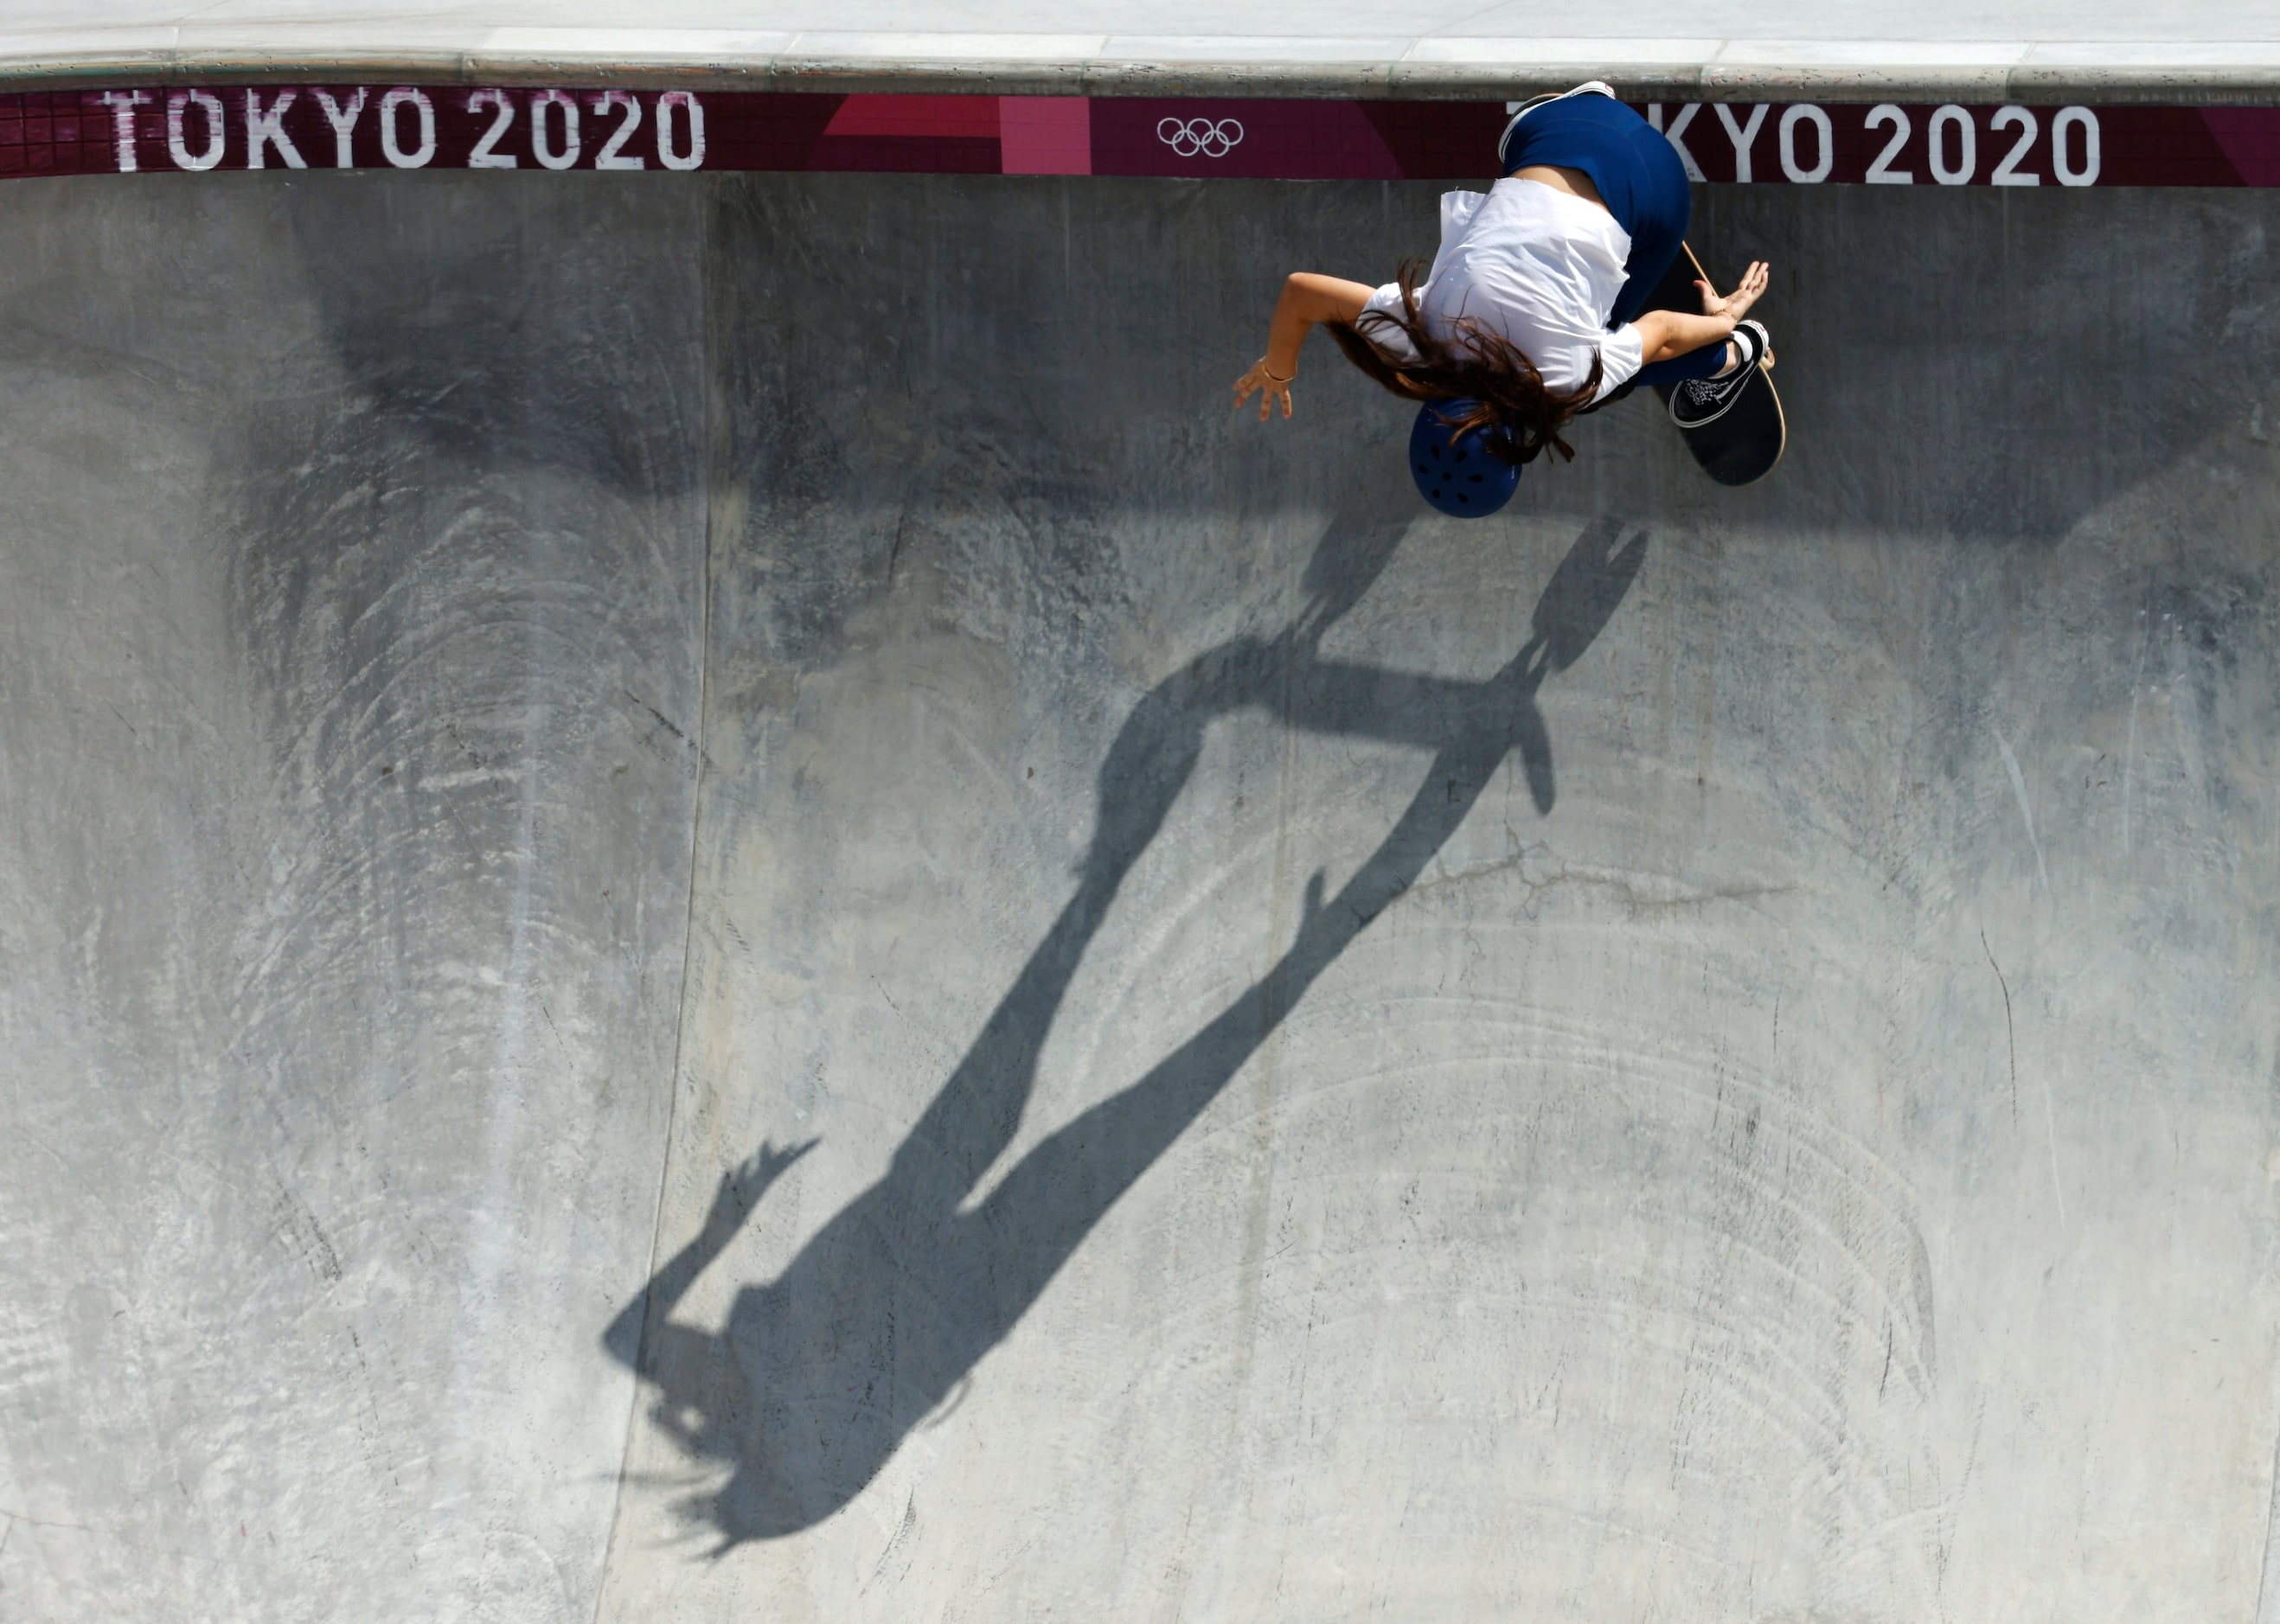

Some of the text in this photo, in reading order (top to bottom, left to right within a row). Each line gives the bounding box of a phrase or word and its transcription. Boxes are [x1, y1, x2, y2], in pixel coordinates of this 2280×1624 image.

[97, 87, 705, 172] TOKYO 2020
[1506, 101, 2101, 187] KYO 2020
